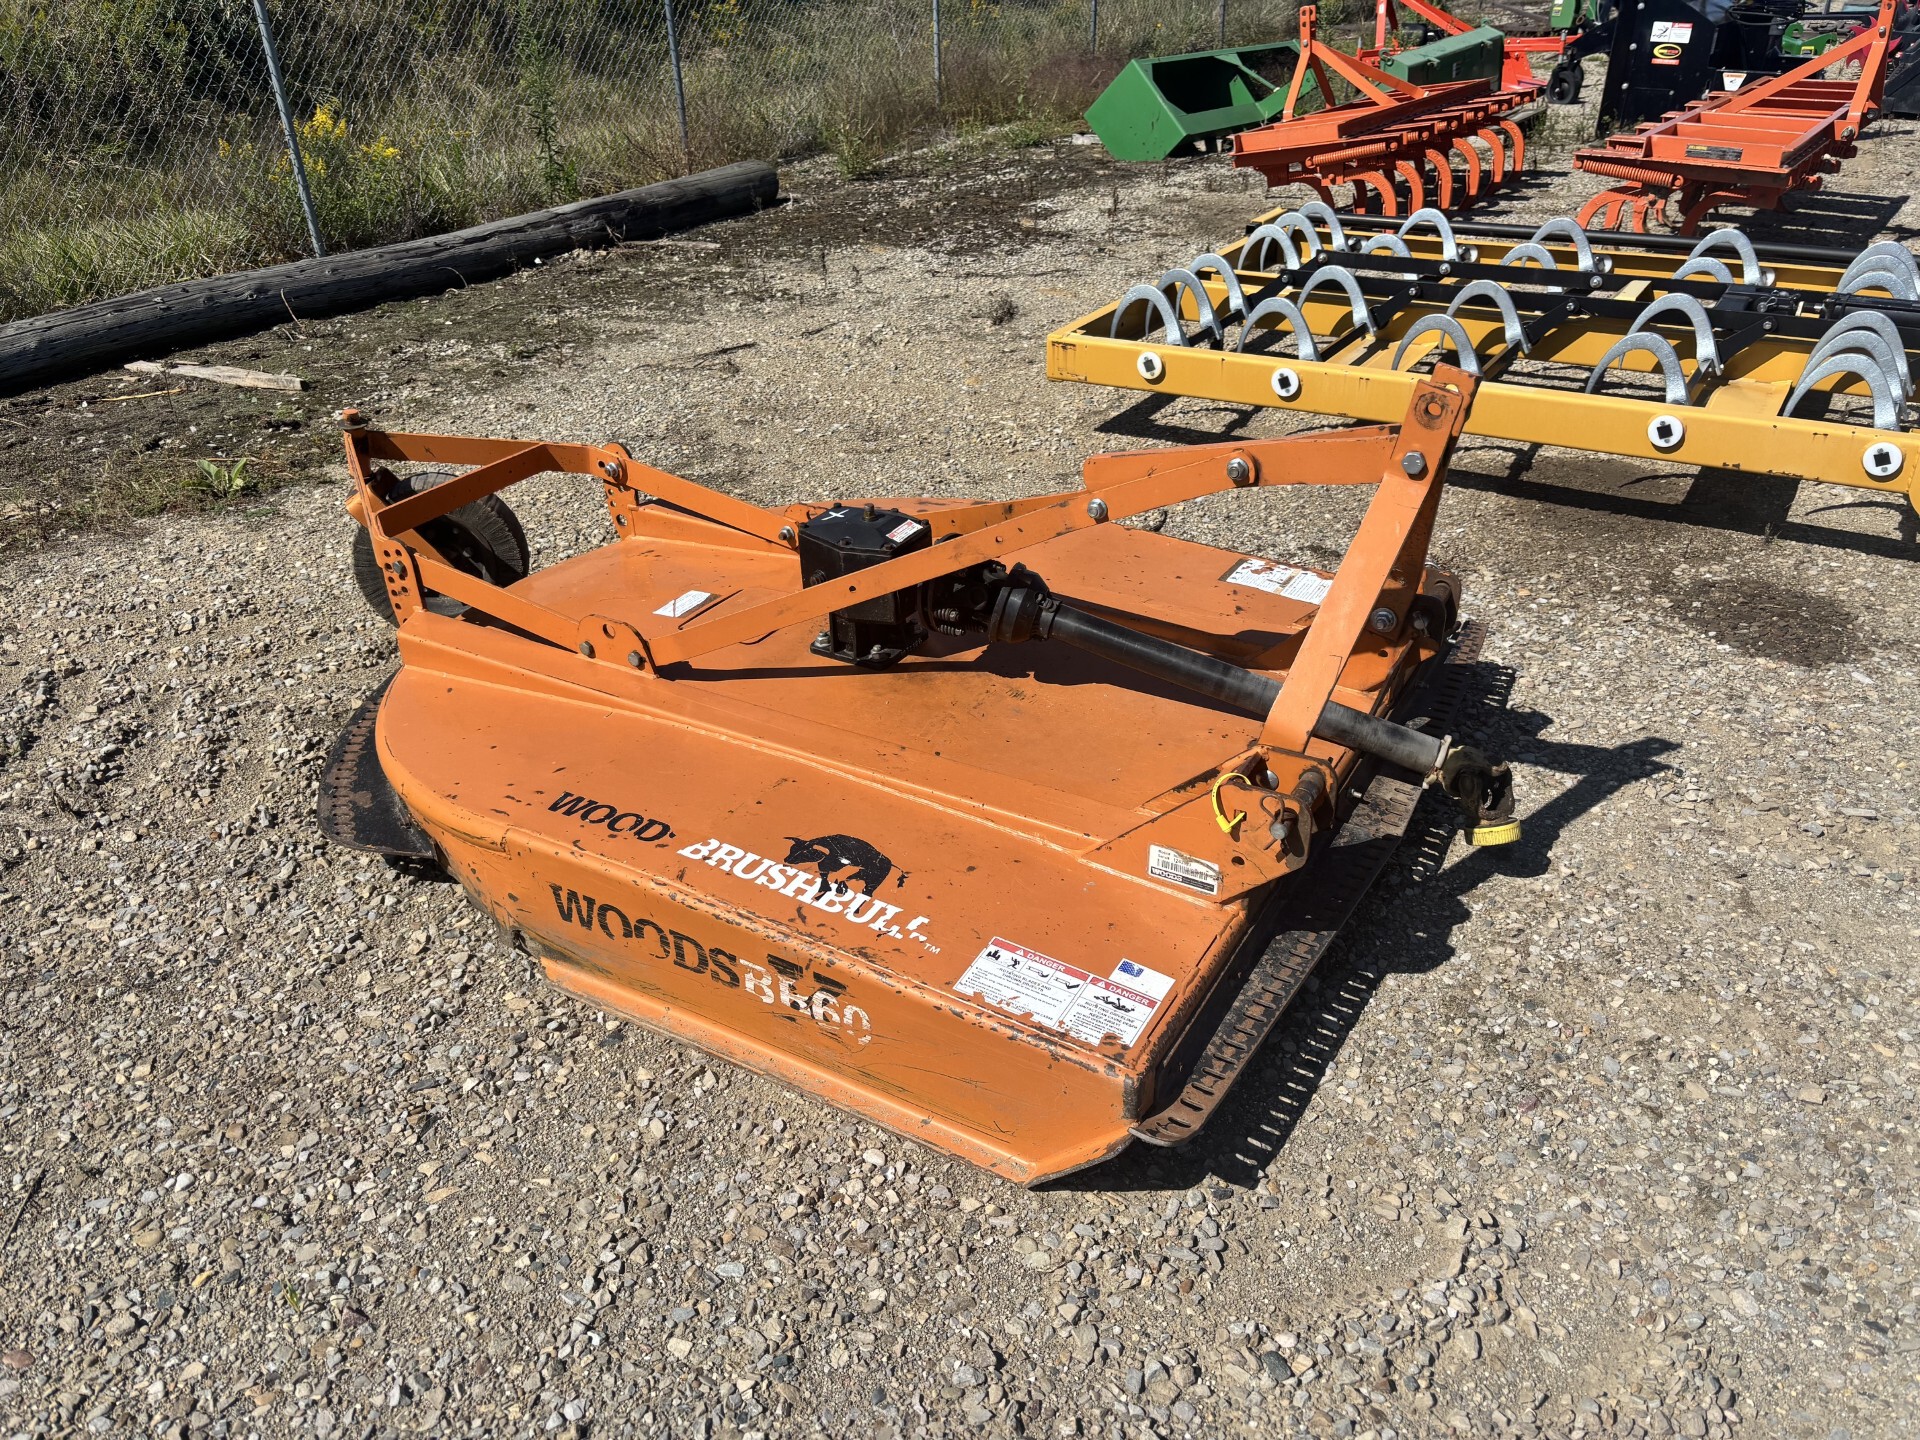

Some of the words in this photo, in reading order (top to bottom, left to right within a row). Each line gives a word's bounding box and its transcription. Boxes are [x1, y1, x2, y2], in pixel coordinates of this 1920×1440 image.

[547, 790, 677, 842] WOOD
[1152, 867, 1182, 882] WOODS
[549, 883, 741, 989] WOODS
[1025, 952, 1066, 972] DANGER
[1106, 985, 1150, 1005] DANGER
